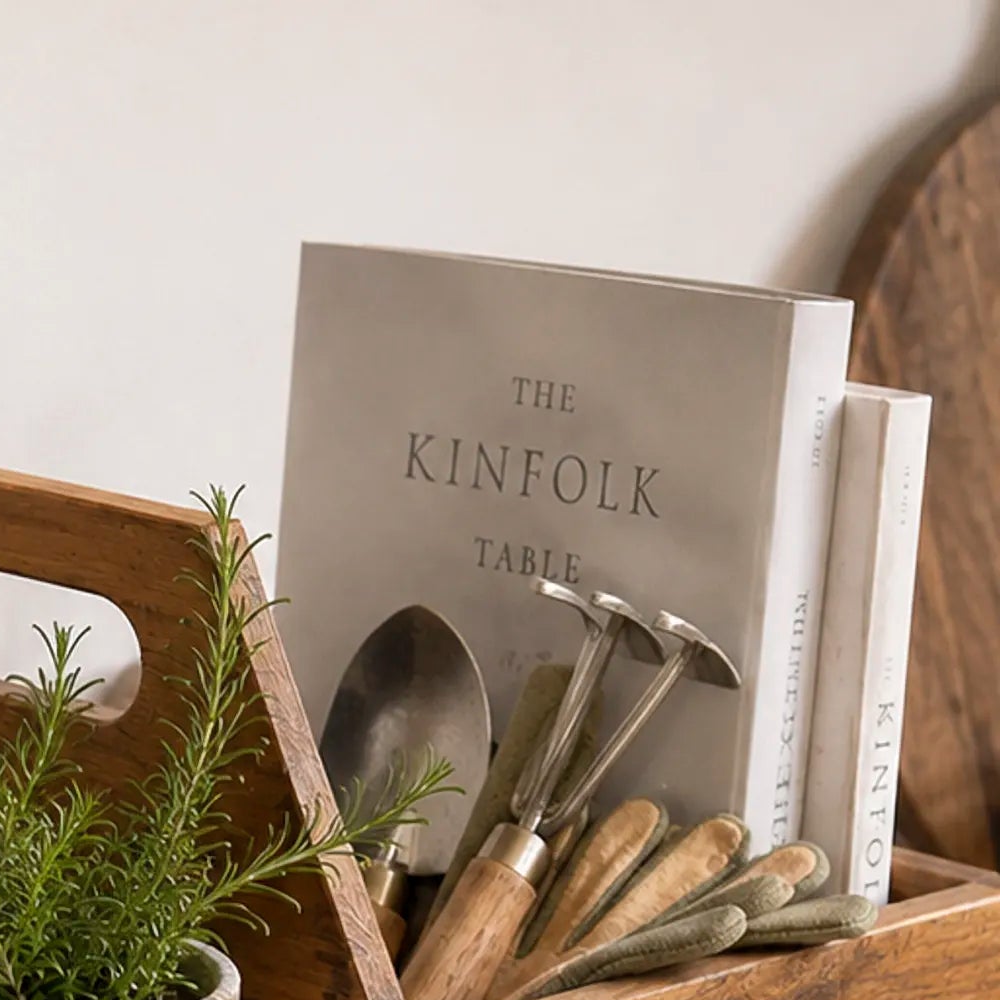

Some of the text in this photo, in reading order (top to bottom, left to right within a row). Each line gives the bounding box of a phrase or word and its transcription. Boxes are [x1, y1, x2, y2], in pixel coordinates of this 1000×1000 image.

[512, 376, 576, 413] THE
[405, 432, 660, 518] KINFOLK
[474, 537, 582, 585] TABLE
